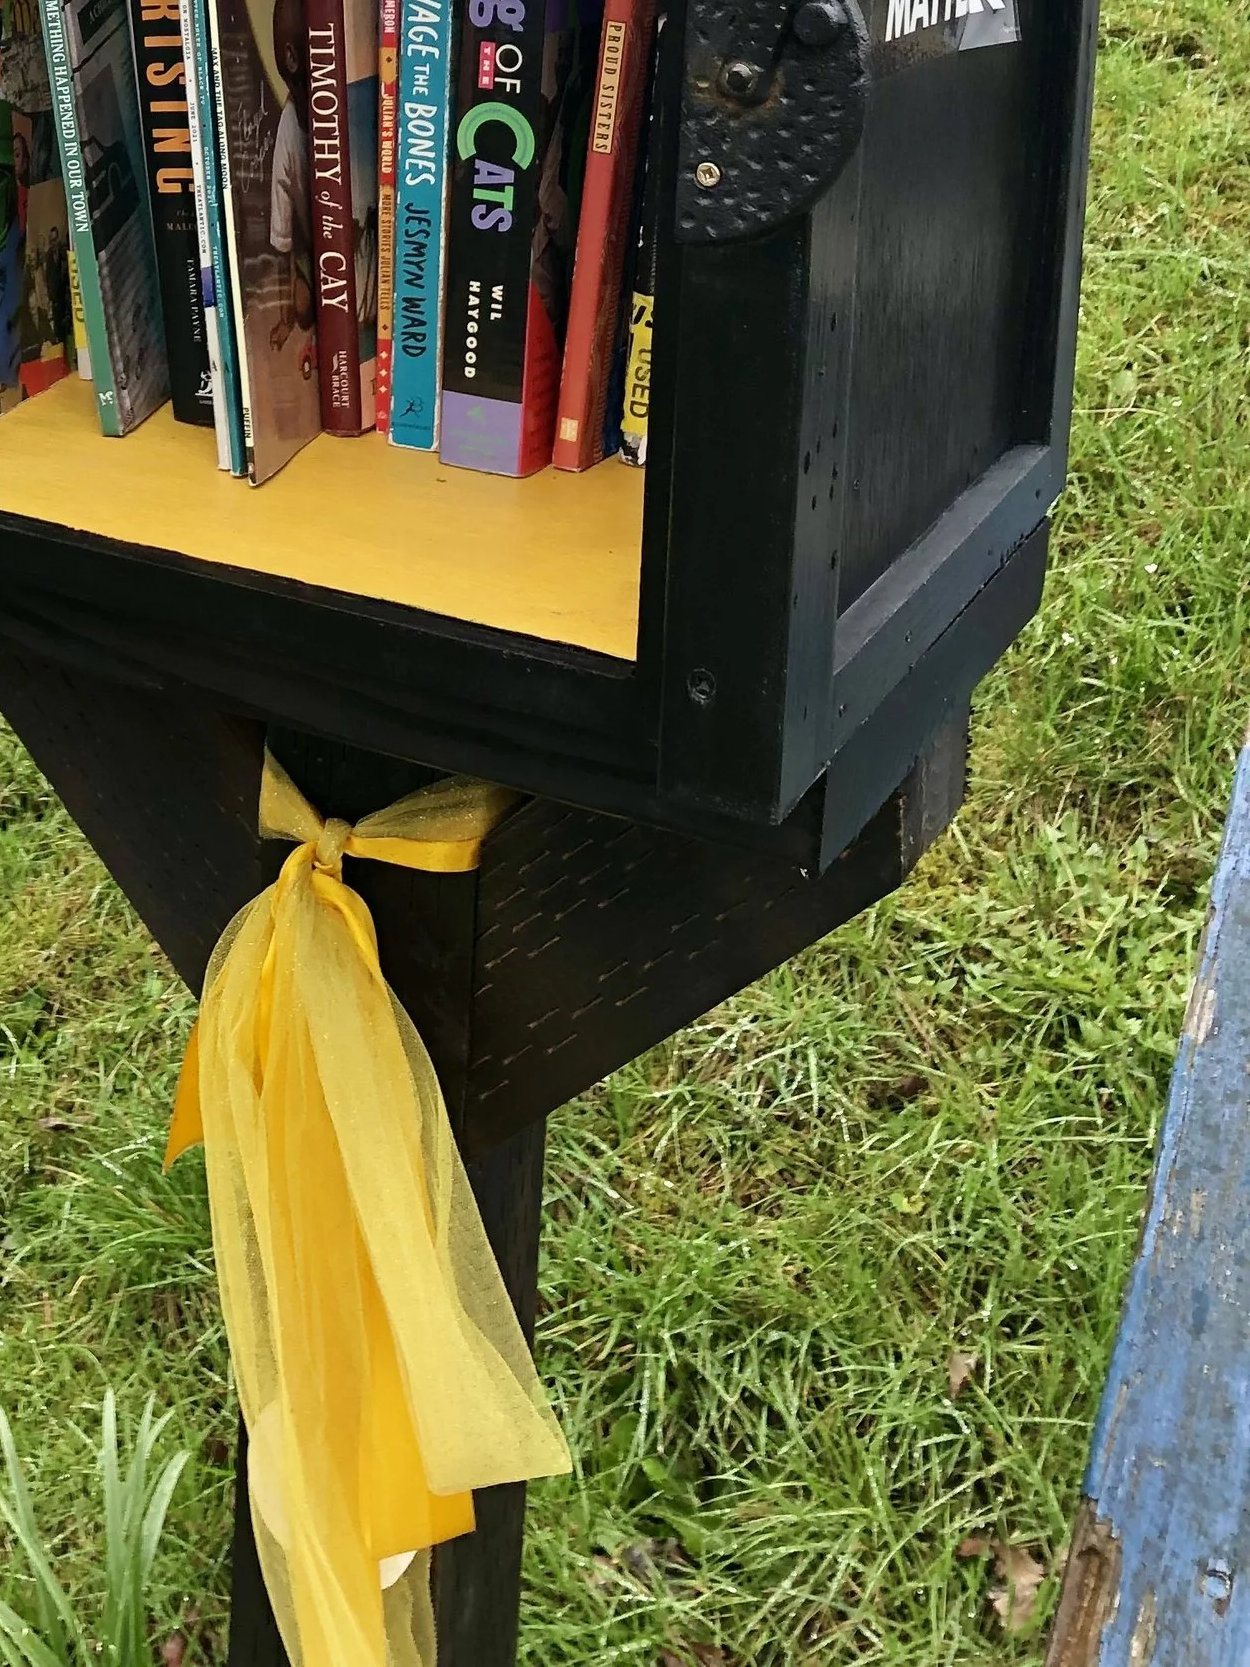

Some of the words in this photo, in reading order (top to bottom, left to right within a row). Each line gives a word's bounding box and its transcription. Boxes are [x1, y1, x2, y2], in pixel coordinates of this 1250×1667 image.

[182, 5, 189, 17] ON
[183, 18, 193, 60] NOSTALGIA
[211, 47, 219, 66] MAX
[604, 23, 624, 76] PROUD
[213, 69, 221, 87] AND
[413, 64, 431, 96] THE
[480, 46, 493, 86] THE
[494, 43, 524, 95] OF
[54, 64, 76, 139] HAPPENED
[214, 89, 222, 108] THE
[308, 23, 343, 186] TIMOTHY
[382, 92, 395, 138] JULIAN'S
[594, 83, 616, 151] SISTERS
[64, 142, 78, 157] IN
[381, 139, 393, 174] WORLD
[404, 101, 438, 186] BONES
[66, 159, 82, 189] OUR
[221, 163, 229, 190] MOON
[455, 101, 536, 233] CATS
[71, 191, 89, 233] TOWN
[195, 184, 207, 254] THEATLANTIC.COM
[315, 190, 343, 212] of
[382, 193, 392, 216] MORE
[321, 215, 344, 240] the
[380, 216, 392, 254] STORIES
[401, 202, 432, 290] JESMYN
[186, 258, 200, 302] TAMARA
[318, 251, 349, 314] CAY
[379, 254, 392, 283] JULIAN
[379, 283, 391, 311] TELLS
[489, 285, 504, 321] WIL
[191, 303, 203, 344] PAYNE
[400, 295, 428, 359] WARD
[463, 280, 482, 379] HAYGOOD
[331, 375, 341, 409] BRACE
[338, 350, 350, 409] HARCOURT
[629, 347, 651, 420] USED
[243, 407, 252, 438] PUFFIN
